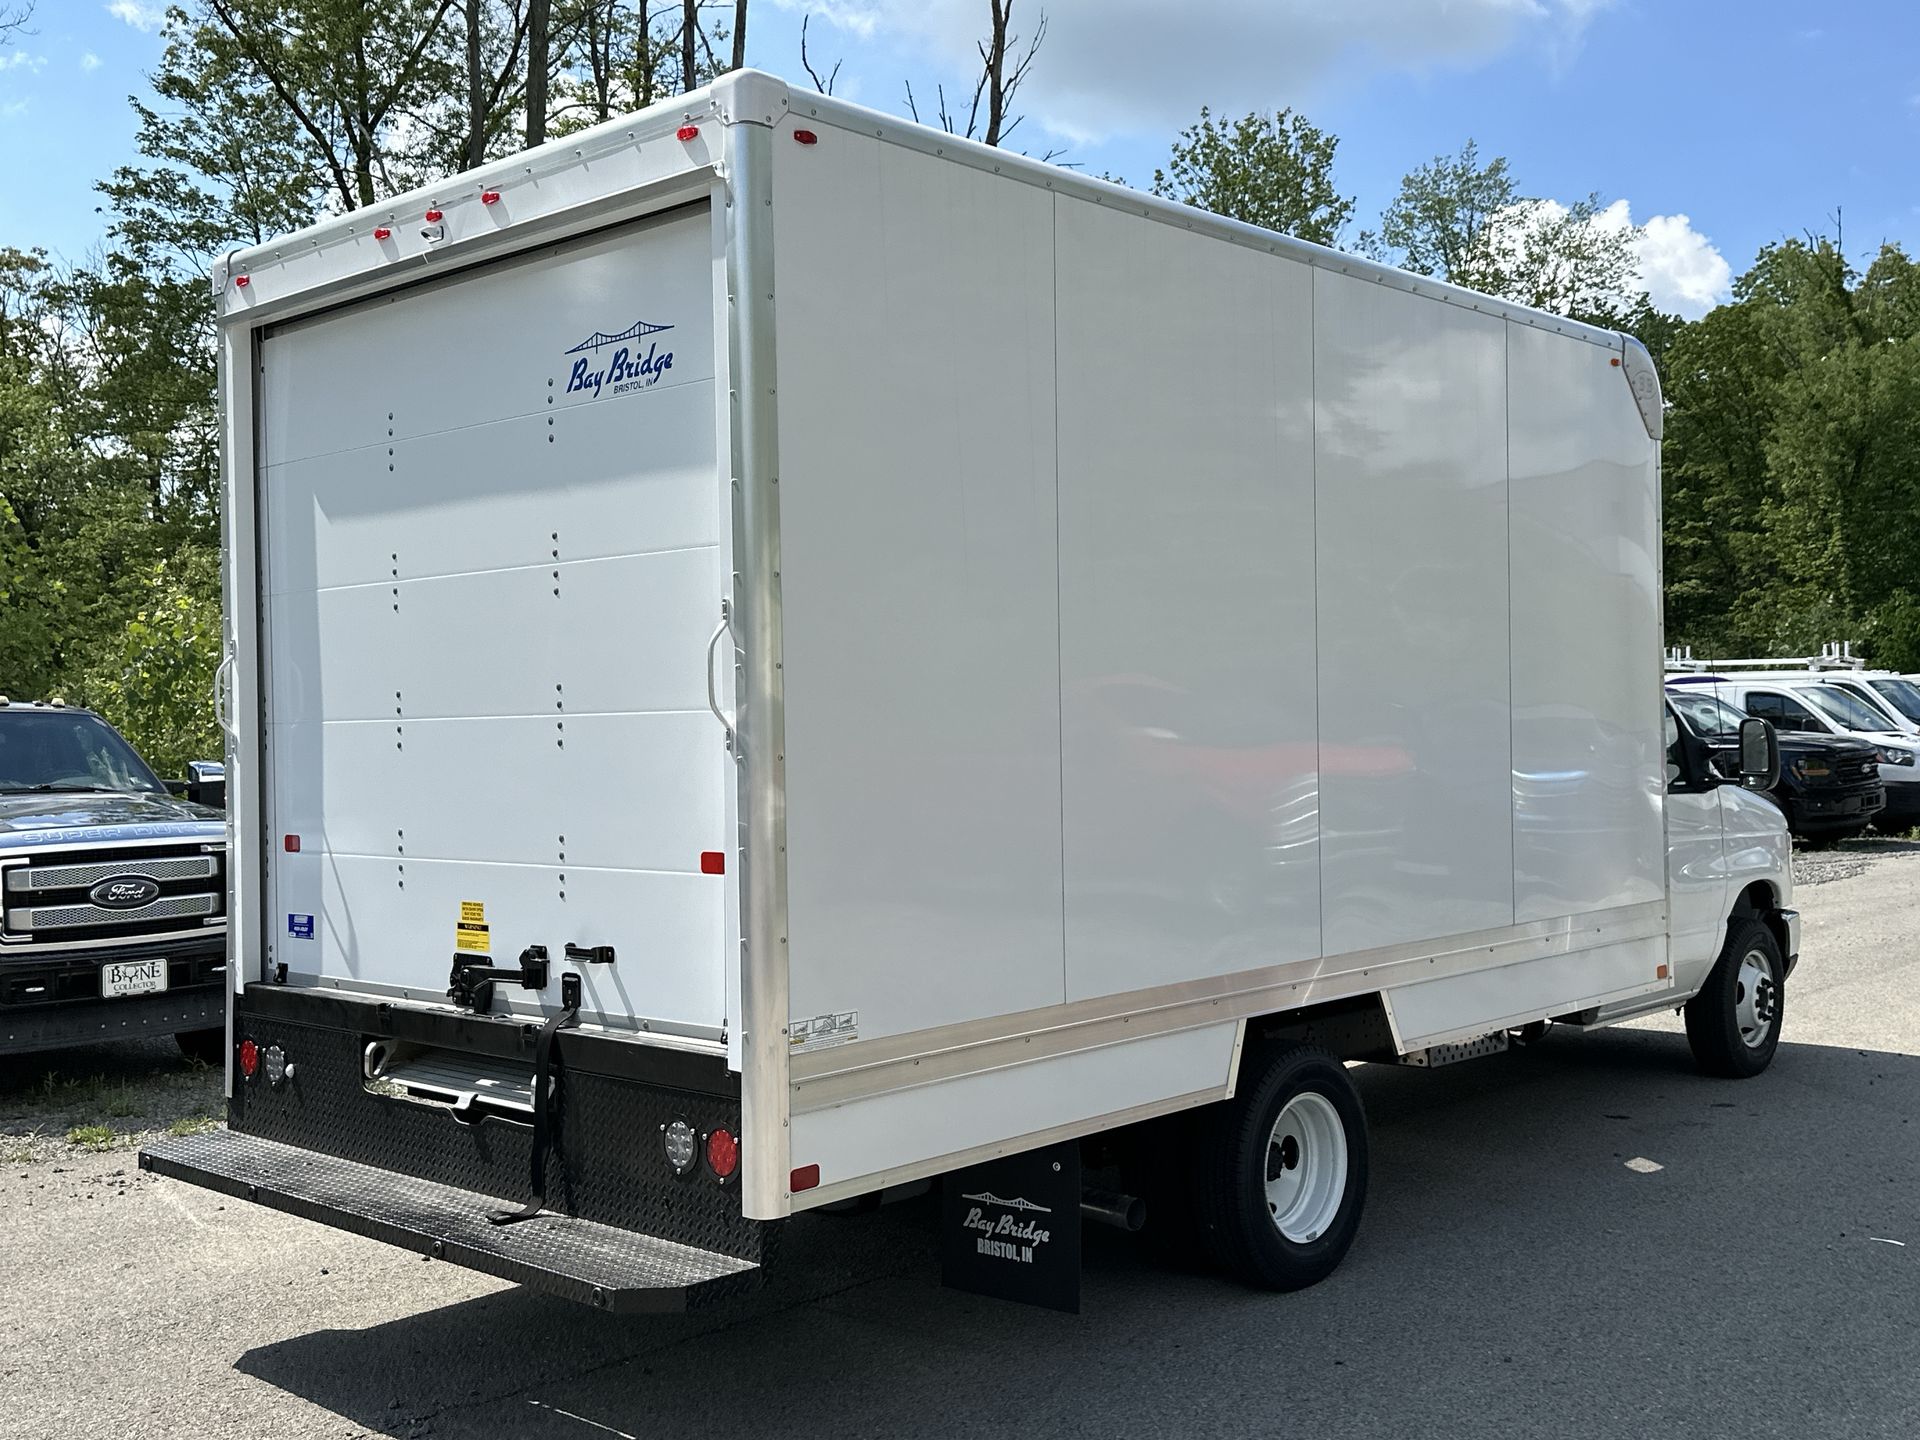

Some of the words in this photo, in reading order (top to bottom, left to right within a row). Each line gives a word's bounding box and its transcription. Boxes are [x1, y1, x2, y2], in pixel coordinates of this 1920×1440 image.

[566, 357, 605, 399] Bay
[605, 342, 674, 384] Bridge
[613, 381, 644, 395] BRISTOL,
[645, 378, 654, 388] IN
[22, 828, 121, 843] SUPER
[107, 883, 146, 901] Ford
[113, 980, 157, 992] COLLECTOR
[963, 1207, 995, 1239] Bay
[994, 1214, 1050, 1248] Bridge
[977, 1237, 1020, 1263] BRISTOL,
[1021, 1246, 1033, 1264] IN
